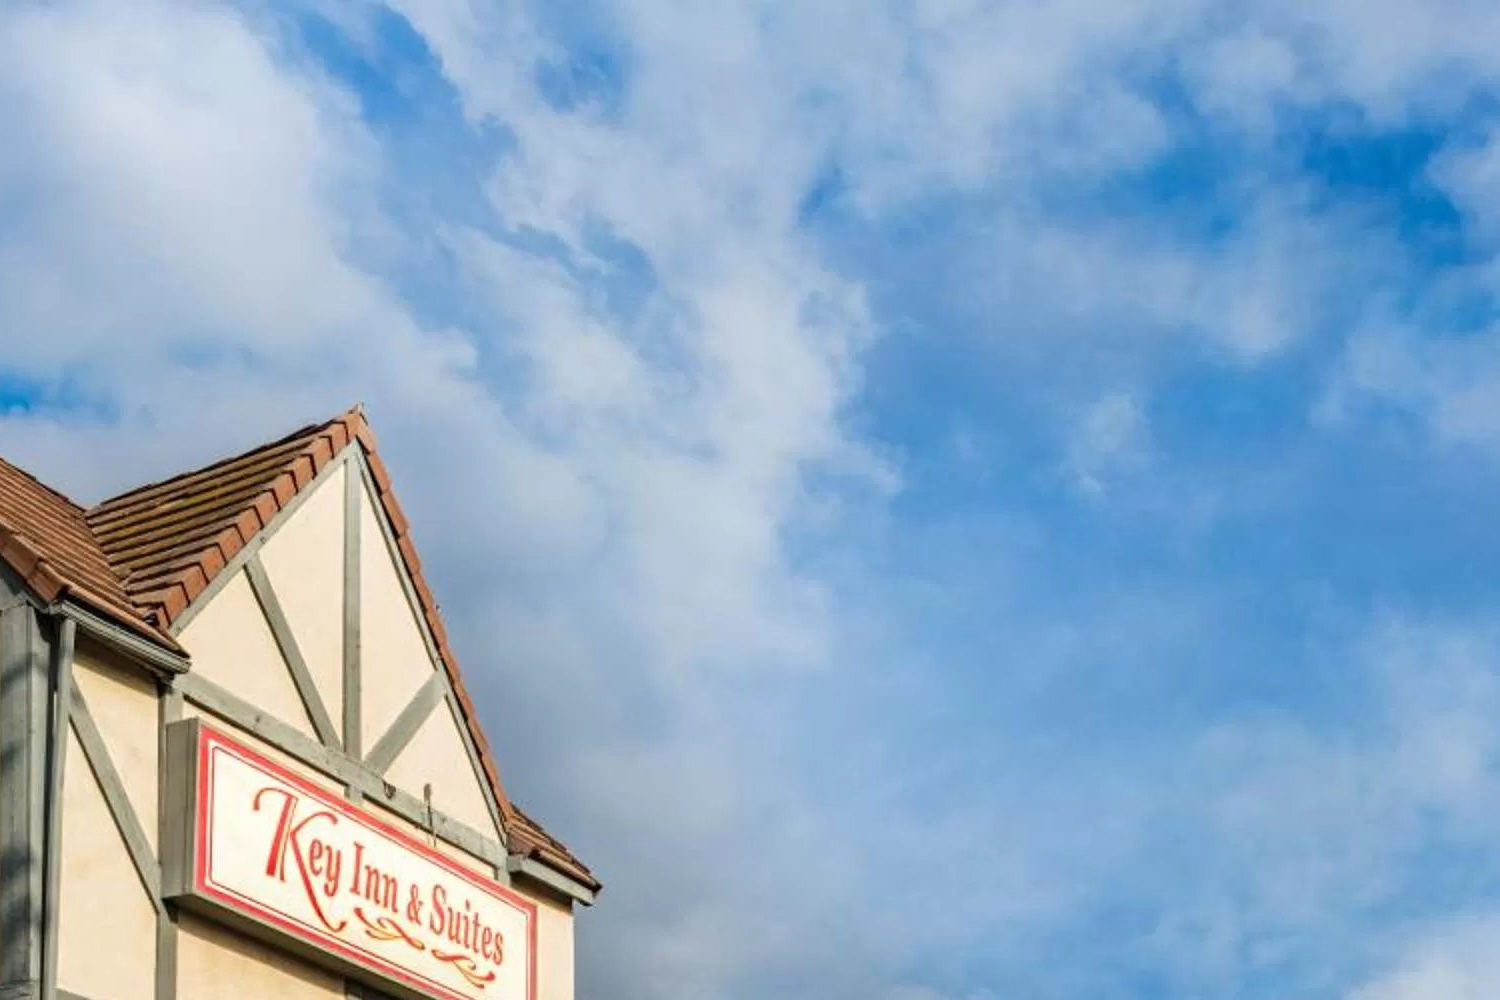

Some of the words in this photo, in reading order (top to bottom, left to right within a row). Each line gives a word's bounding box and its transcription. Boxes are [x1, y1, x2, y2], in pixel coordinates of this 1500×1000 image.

[252, 787, 347, 933] Key
[350, 842, 399, 914] Inn
[407, 884, 423, 927] &
[428, 884, 505, 966] Suites
